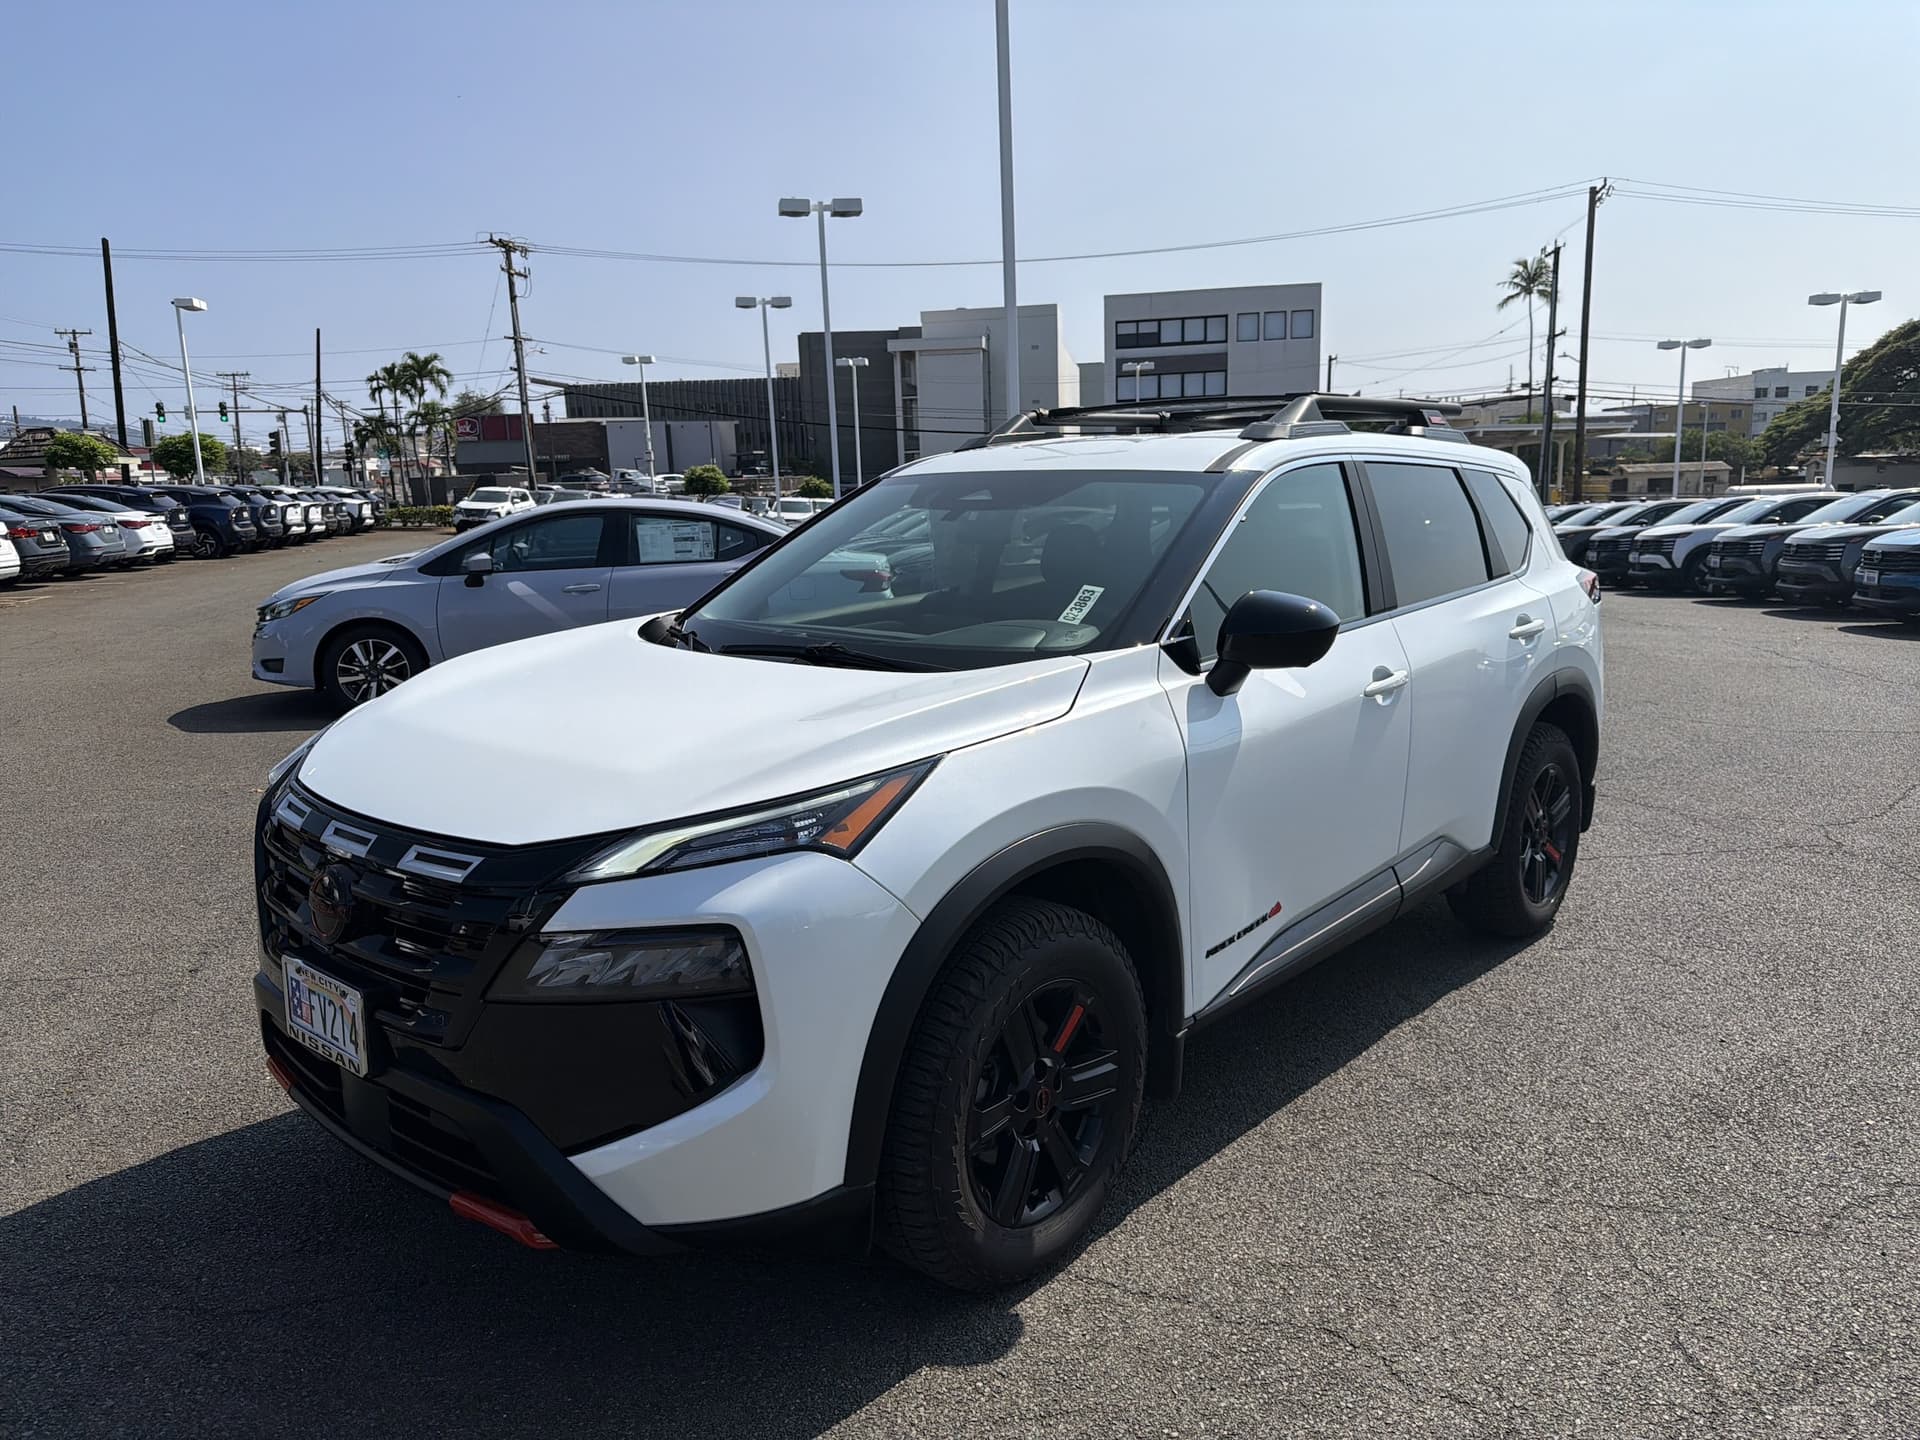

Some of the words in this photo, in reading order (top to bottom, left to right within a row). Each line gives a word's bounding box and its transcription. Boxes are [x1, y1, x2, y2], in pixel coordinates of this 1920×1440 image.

[318, 976, 339, 992] CITY
[308, 987, 359, 1056] FV214
[289, 1024, 361, 1075] NISSAN
